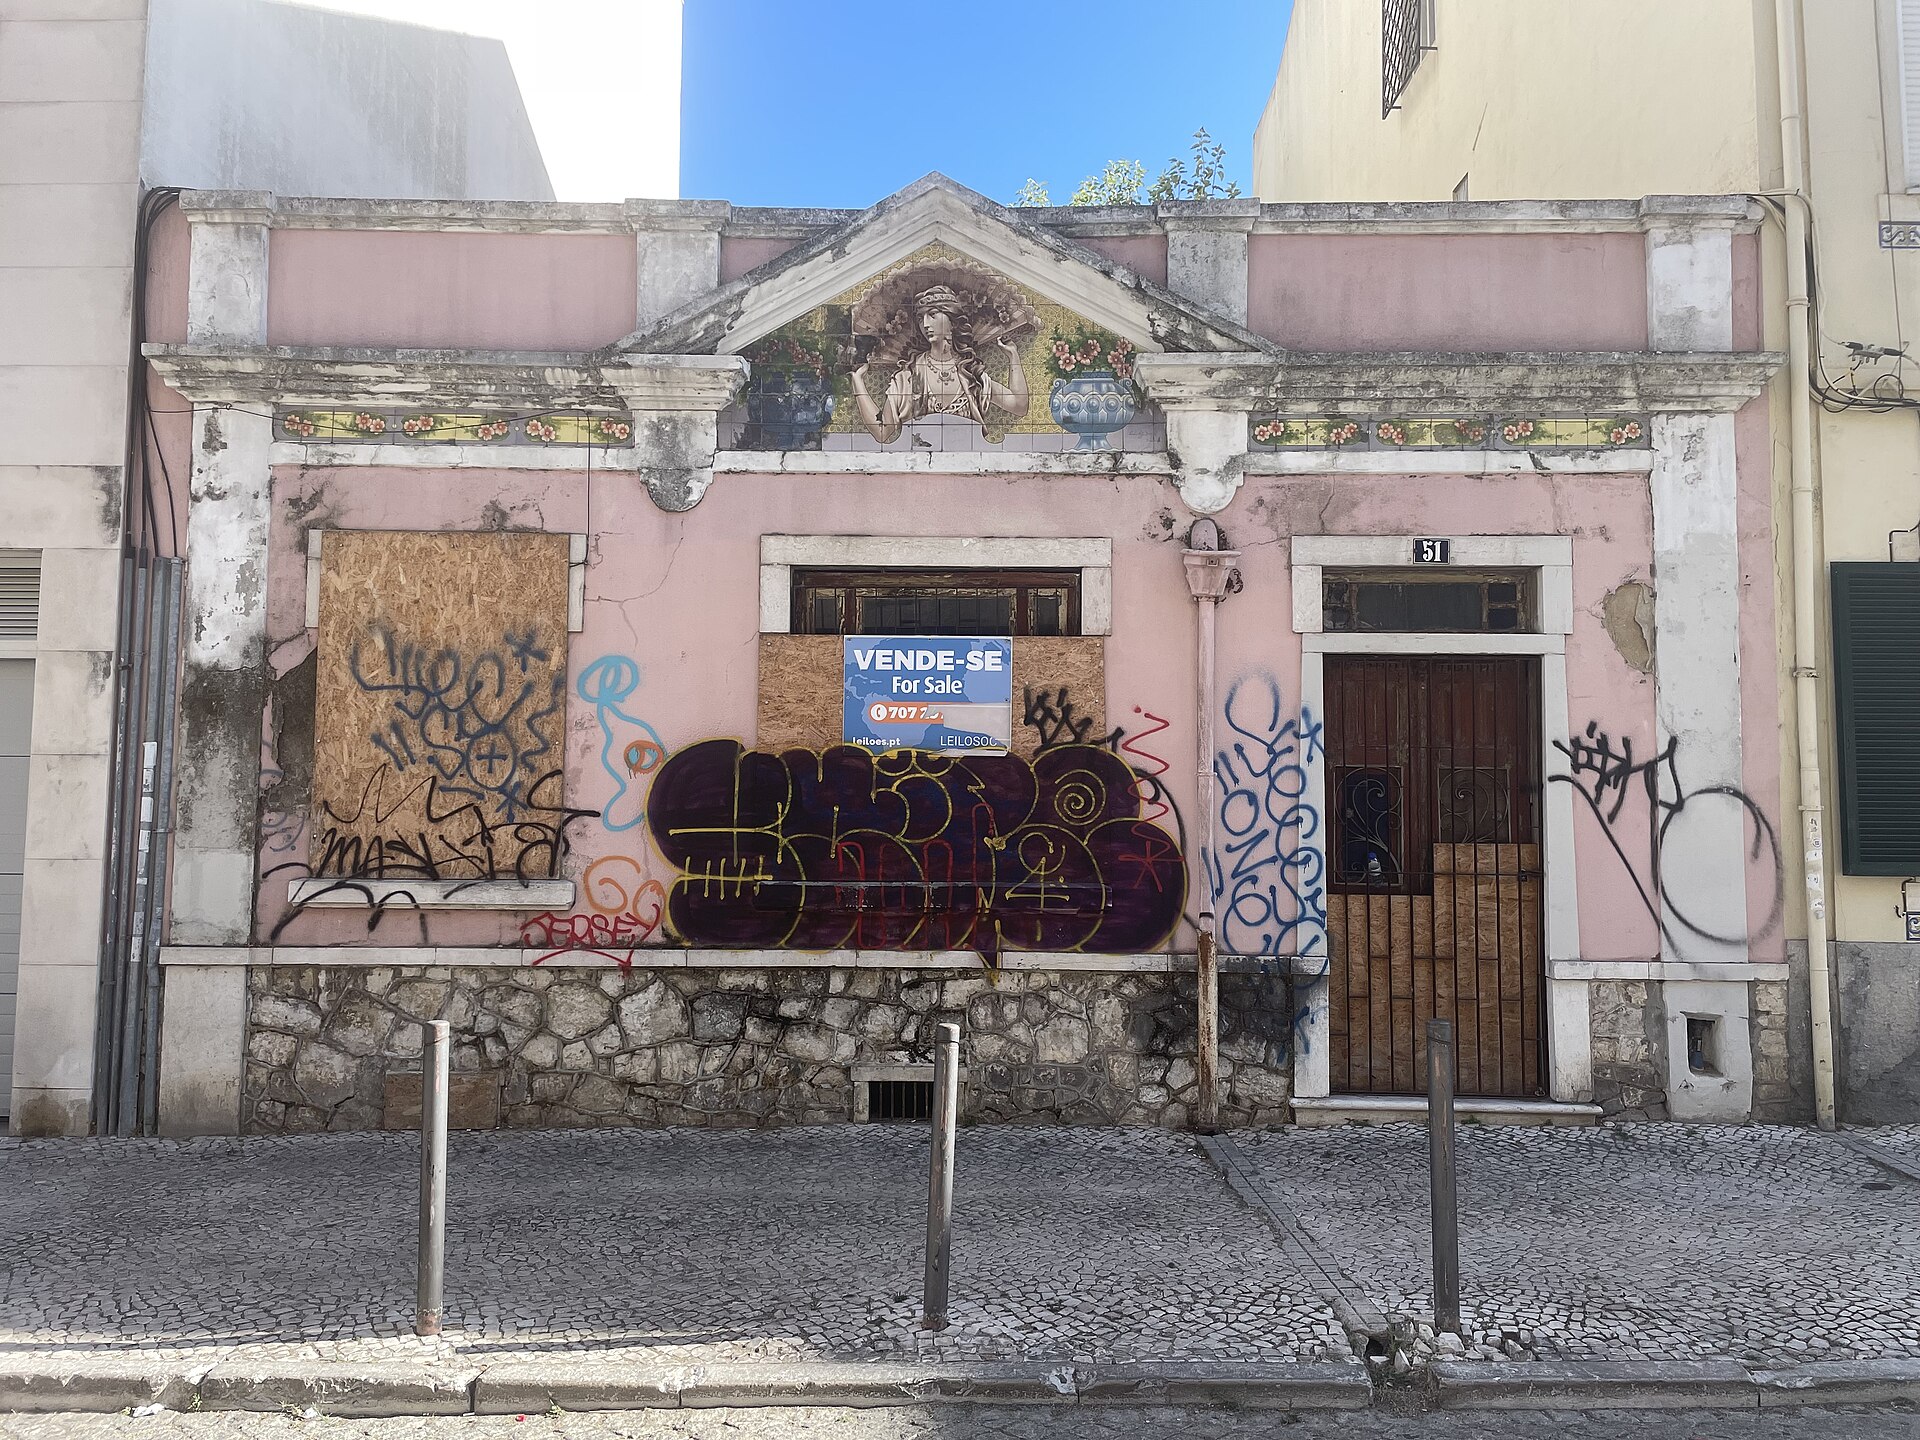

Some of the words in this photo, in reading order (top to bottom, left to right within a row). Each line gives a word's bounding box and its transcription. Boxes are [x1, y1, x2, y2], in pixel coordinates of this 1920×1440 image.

[1422, 540, 1442, 562] 51
[853, 649, 1003, 672] VENDE-SE
[892, 676, 920, 694] For
[924, 675, 963, 694] Sale
[888, 706, 917, 719] 707
[852, 736, 901, 747] leiloes.pt
